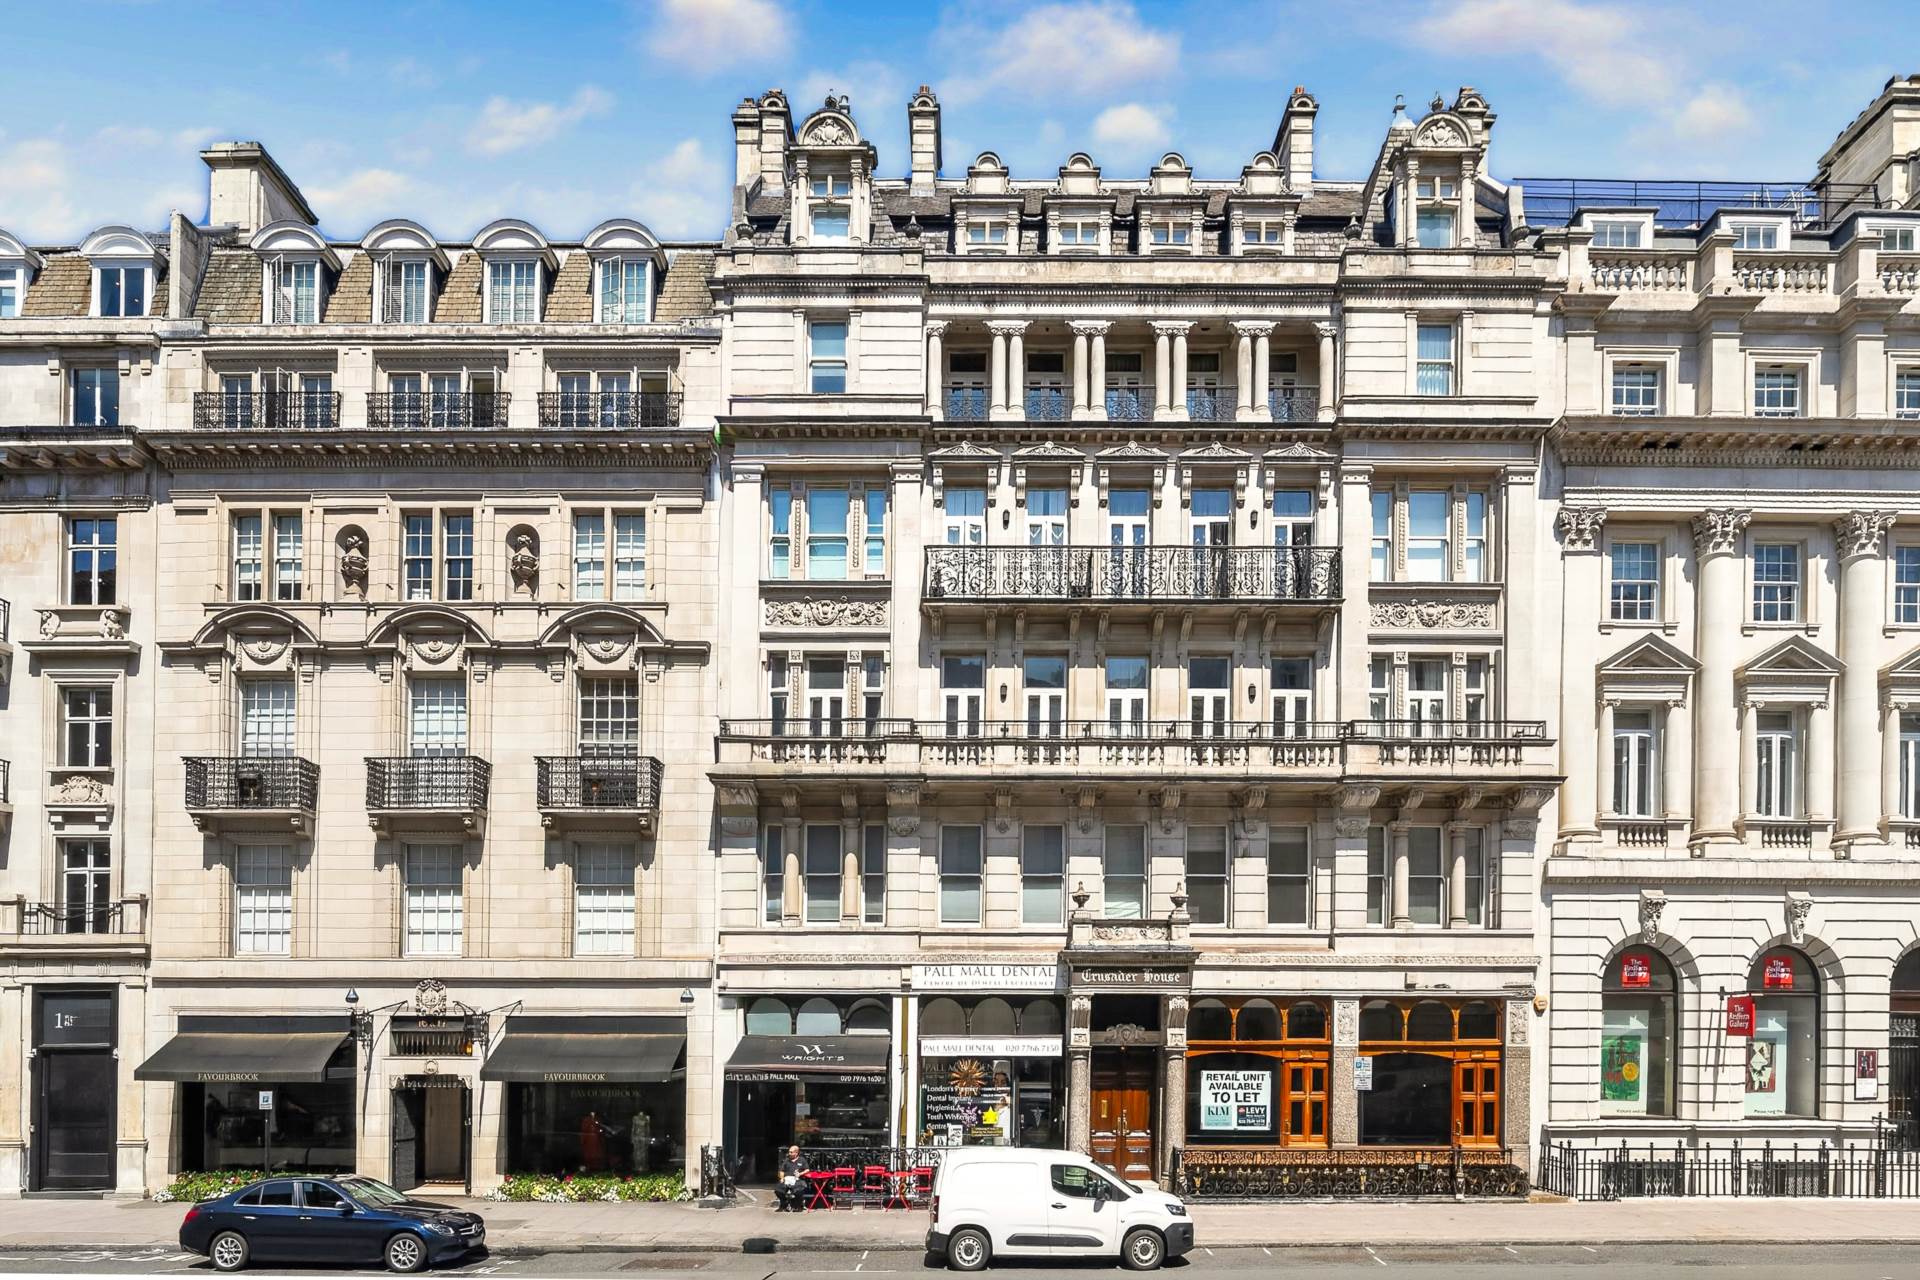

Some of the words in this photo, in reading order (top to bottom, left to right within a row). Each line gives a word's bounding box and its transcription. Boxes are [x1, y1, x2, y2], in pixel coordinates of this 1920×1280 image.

[924, 966, 955, 977] PALL
[960, 966, 996, 977] MALL
[1002, 966, 1055, 977] DENTAL
[1081, 968, 1138, 983] Crusader
[1142, 968, 1180, 984] House
[198, 1073, 259, 1081] FAVOURBROOK
[544, 1073, 606, 1081] FAVOURBROOK
[1206, 1073, 1241, 1081] RETAIL
[1243, 1073, 1266, 1081] UNIT
[1208, 1082, 1263, 1091] AVAILABLE
[1212, 1092, 1231, 1103] TO
[1235, 1092, 1260, 1103] LET
[1246, 1106, 1265, 1114] LEVY
